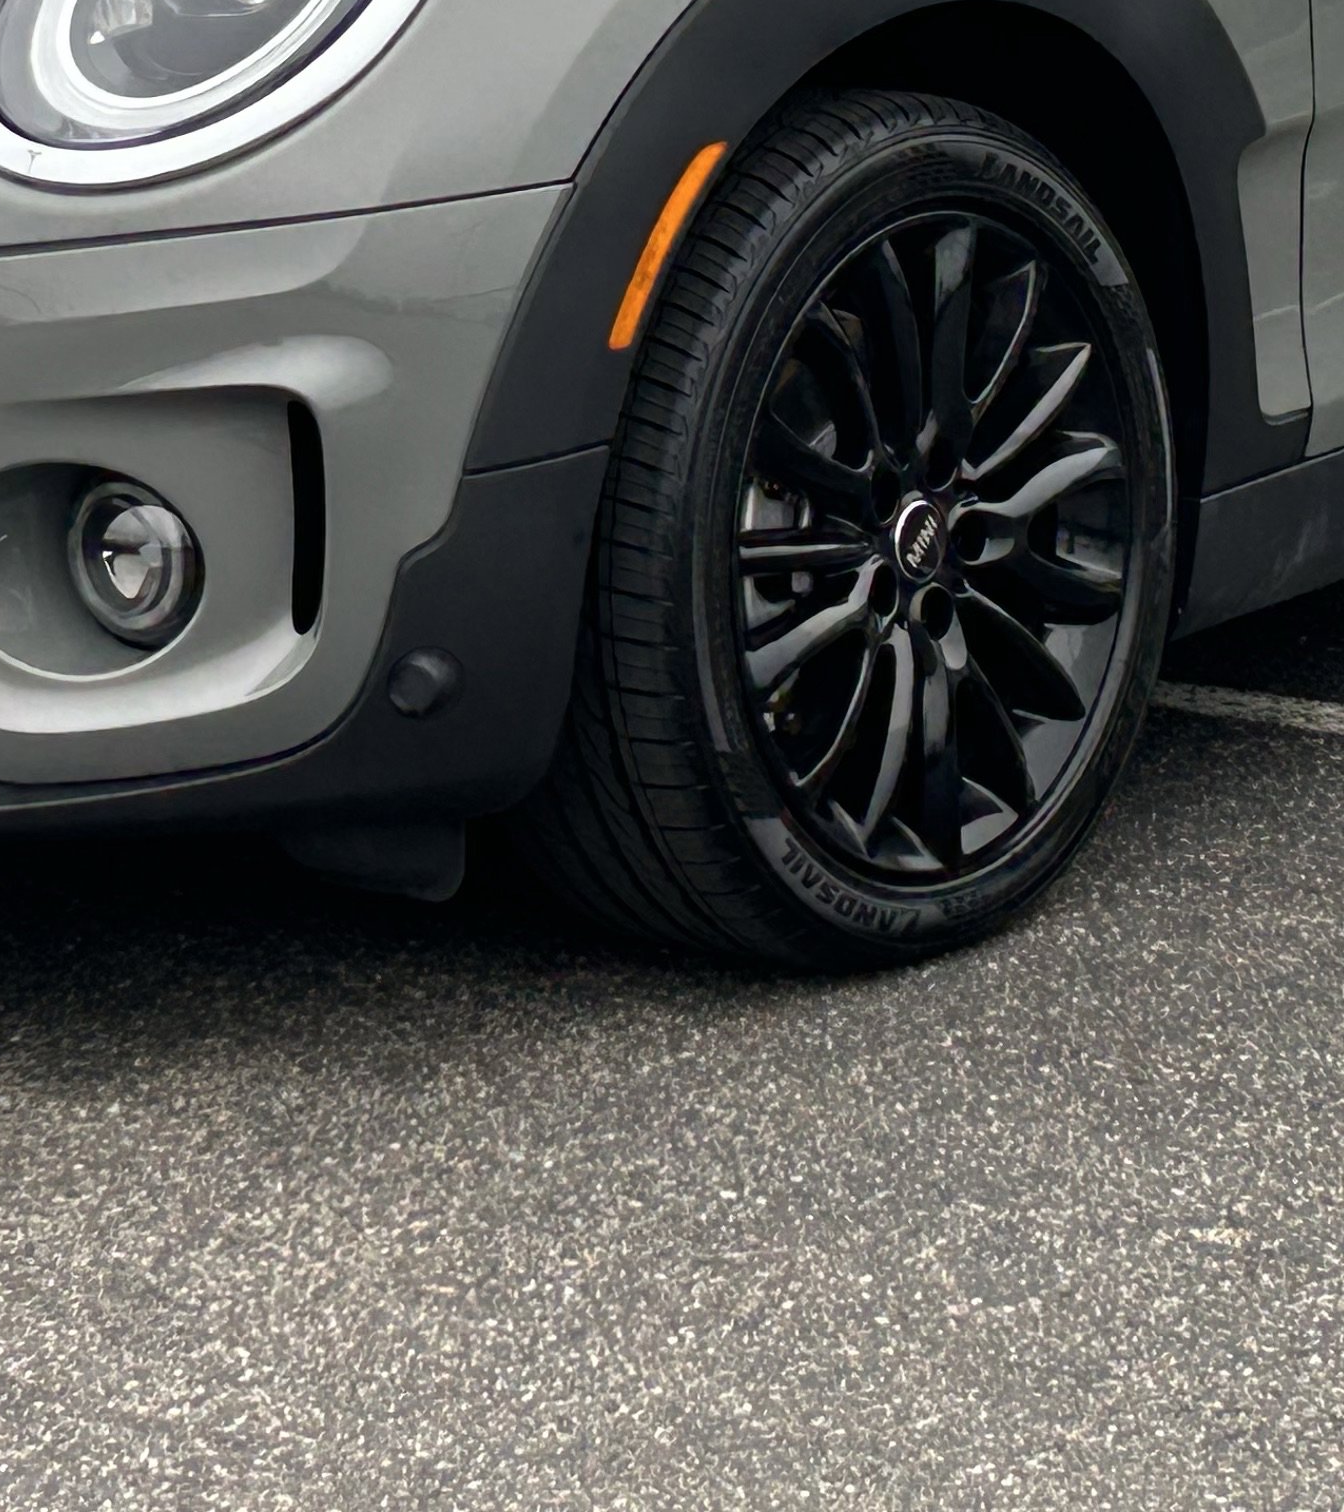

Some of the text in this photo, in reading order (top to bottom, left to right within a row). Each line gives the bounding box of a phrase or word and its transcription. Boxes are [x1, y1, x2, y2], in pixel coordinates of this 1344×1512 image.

[980, 151, 1102, 266] LANDSAIL
[906, 513, 938, 568] MINI
[780, 838, 922, 936] LANDSAIL
